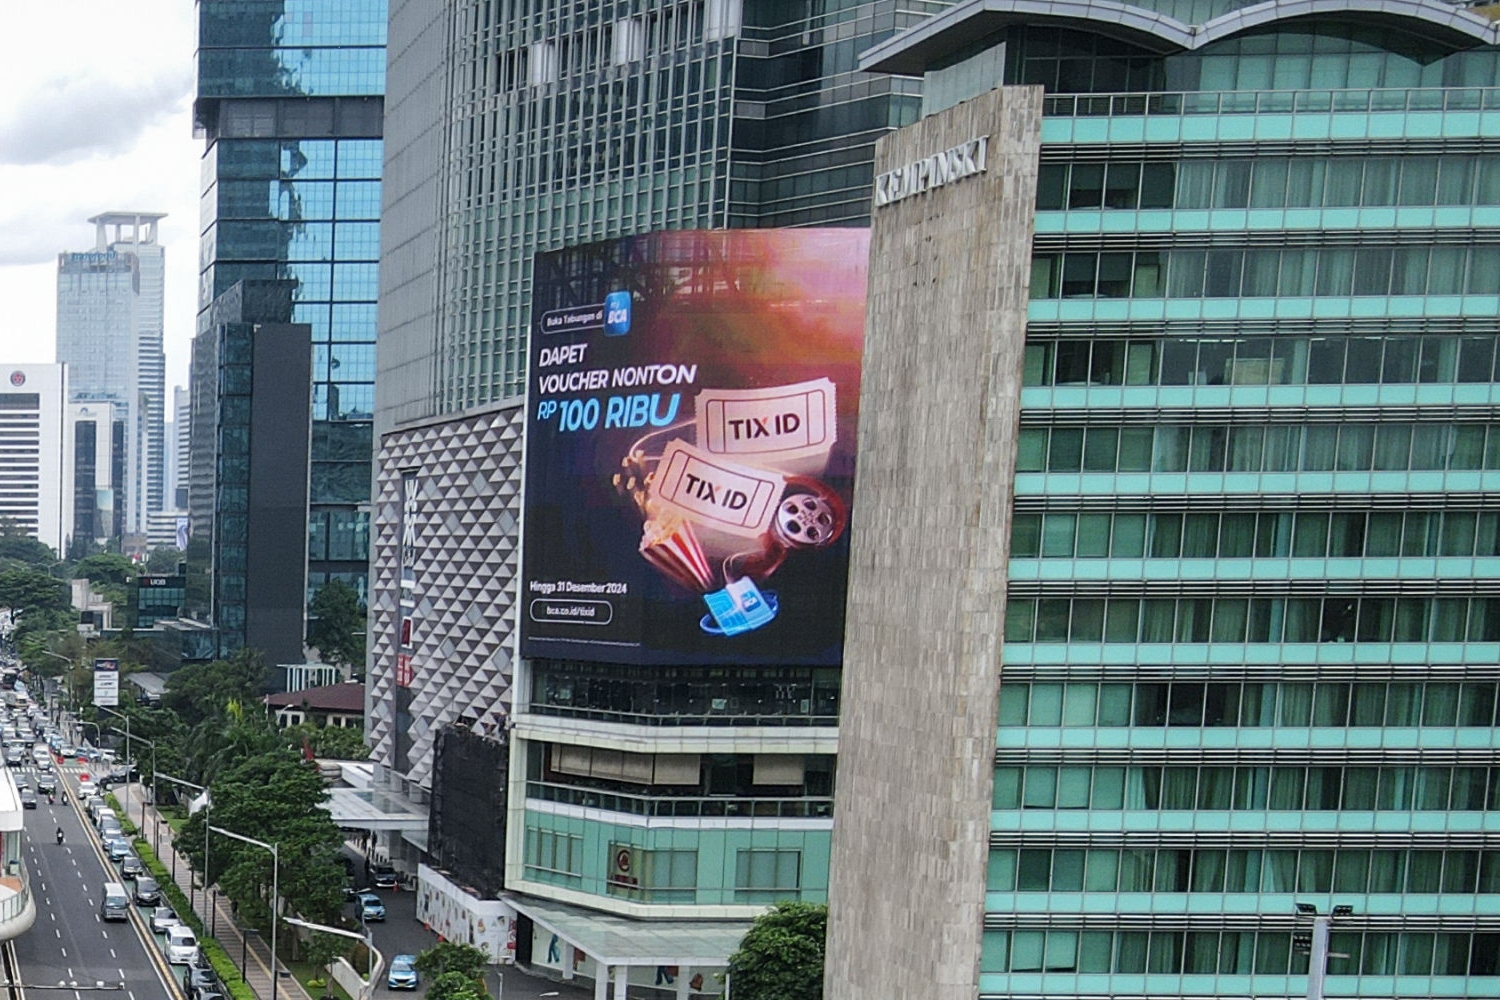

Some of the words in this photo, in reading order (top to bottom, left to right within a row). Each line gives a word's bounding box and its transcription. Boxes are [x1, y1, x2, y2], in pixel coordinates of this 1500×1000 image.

[875, 134, 990, 207] KEMPINSKI
[607, 308, 628, 324] BCA
[538, 343, 588, 367] DAPET
[538, 369, 609, 394] VOUCHER
[611, 364, 698, 388] NONTON
[537, 400, 557, 421] RP
[558, 398, 600, 432] 100
[604, 393, 681, 429] RIBU
[728, 417, 770, 440] TIX
[774, 413, 801, 436] ID
[685, 473, 722, 505] TIX
[721, 489, 748, 510] ID
[529, 580, 556, 594] Hingga
[556, 581, 565, 592] 31
[565, 581, 605, 593] Desember
[605, 582, 628, 594] 2024
